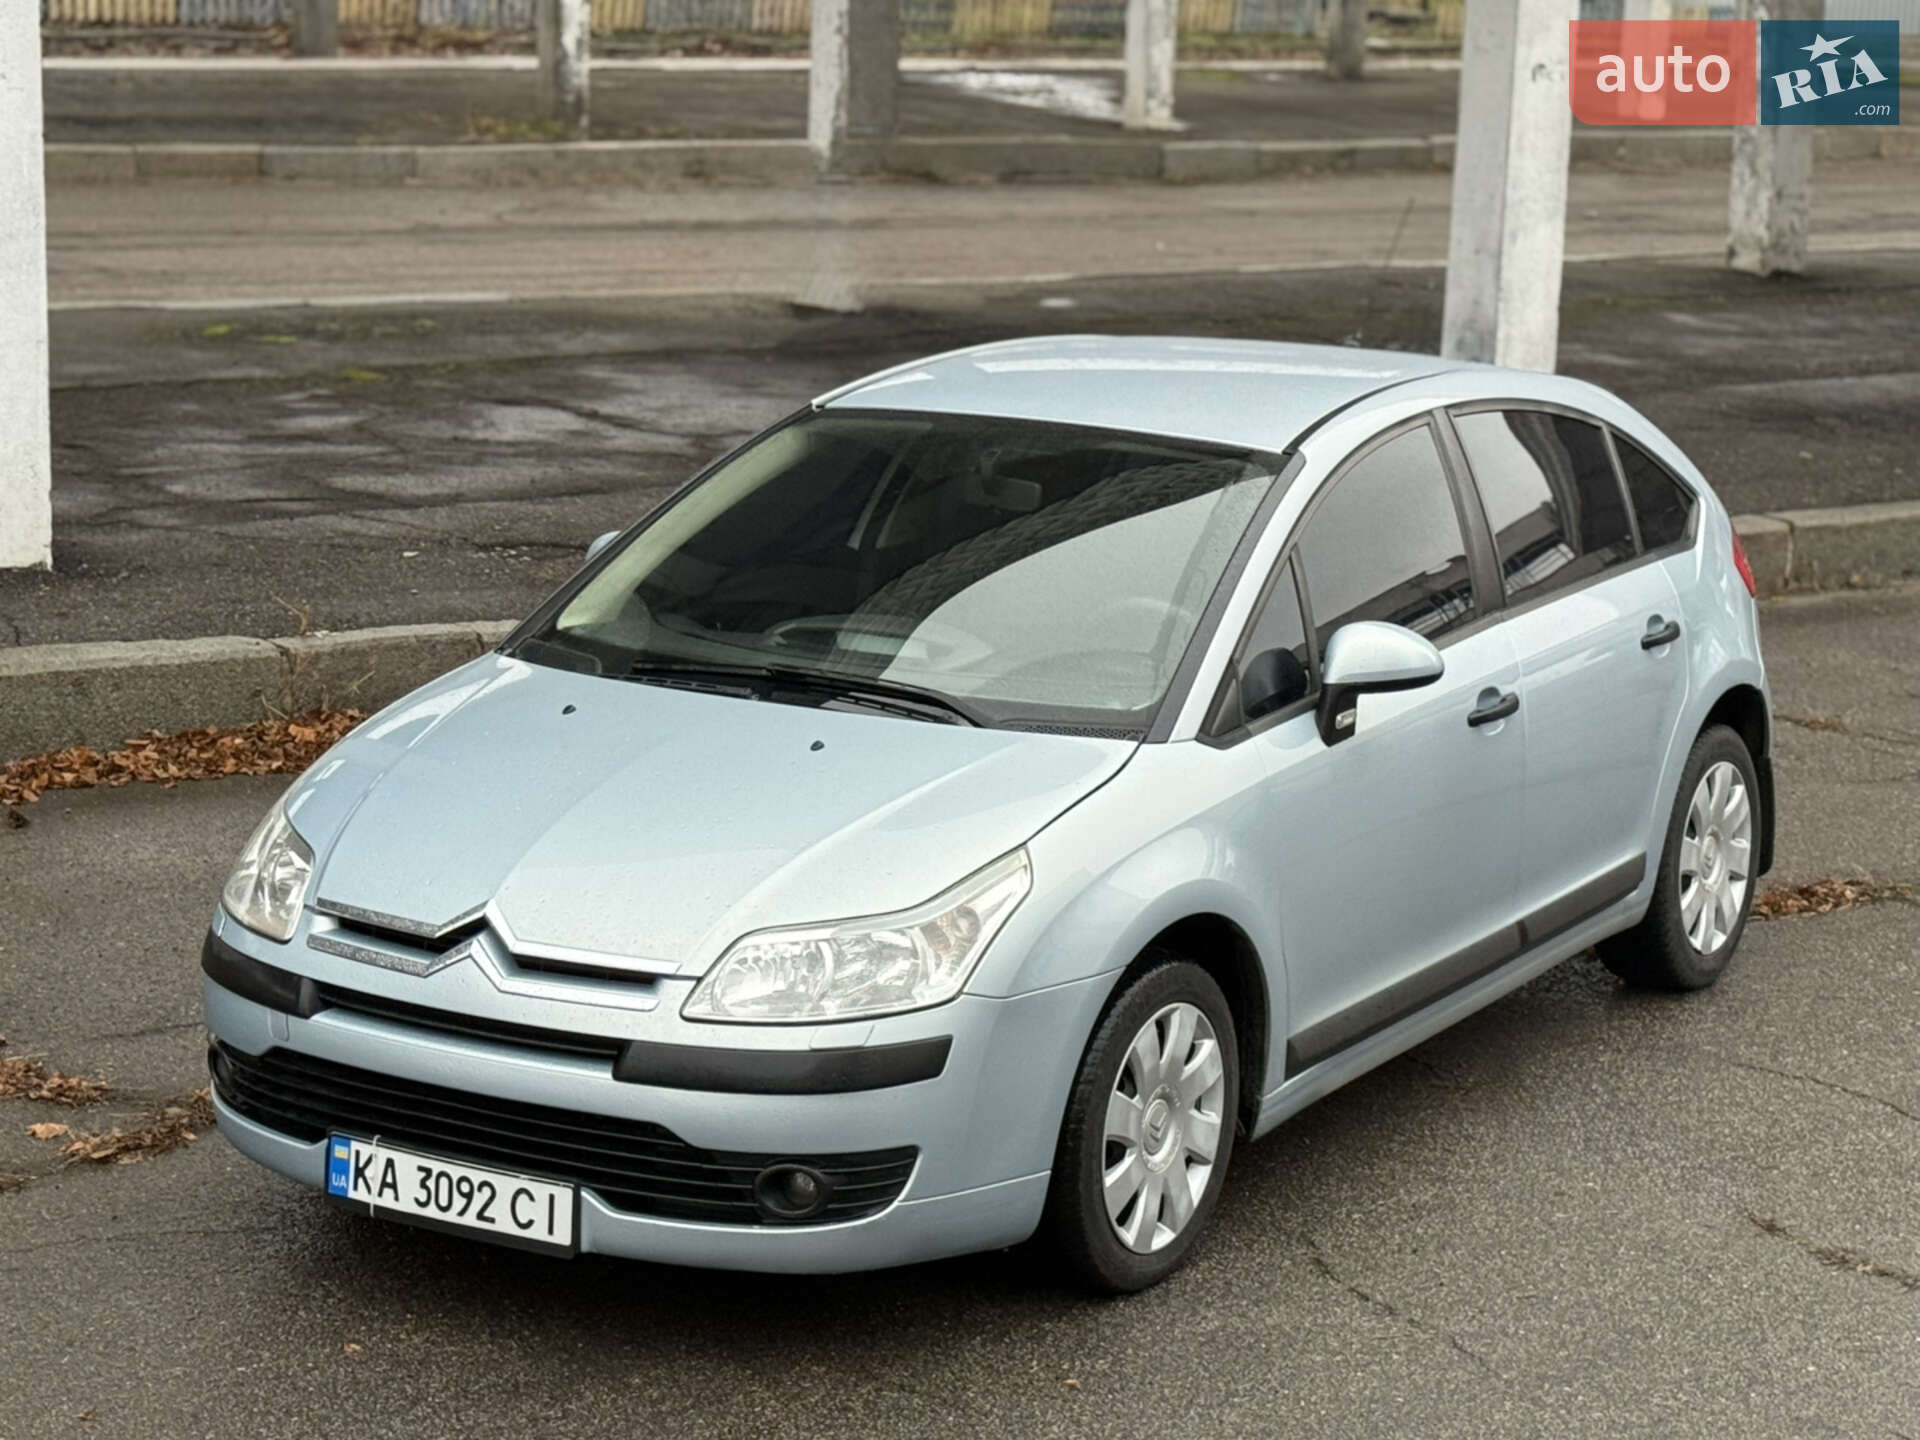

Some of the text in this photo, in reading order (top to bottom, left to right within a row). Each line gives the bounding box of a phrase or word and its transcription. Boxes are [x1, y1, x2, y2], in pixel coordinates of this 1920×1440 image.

[331, 1173, 348, 1190] UA
[352, 1149, 556, 1237] KA 3092 CI
